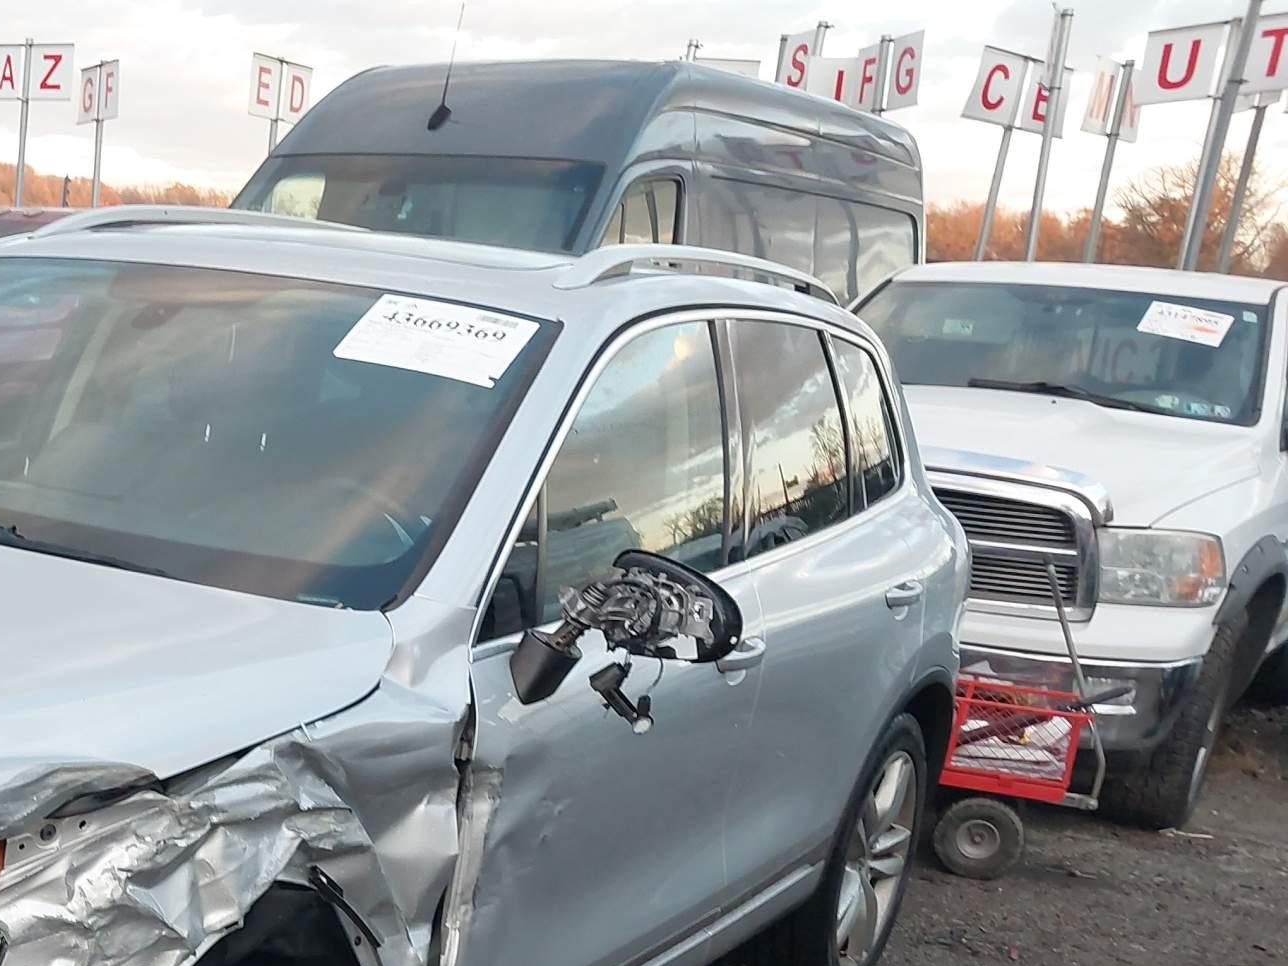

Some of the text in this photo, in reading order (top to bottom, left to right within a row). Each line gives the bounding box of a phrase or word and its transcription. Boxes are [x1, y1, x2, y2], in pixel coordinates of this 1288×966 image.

[39, 53, 64, 91] Z
[786, 43, 809, 88] S
[859, 48, 916, 104] F G
[980, 63, 1012, 112] C
[1156, 39, 1202, 91] U
[82, 71, 115, 113] G F
[255, 66, 306, 113] E D
